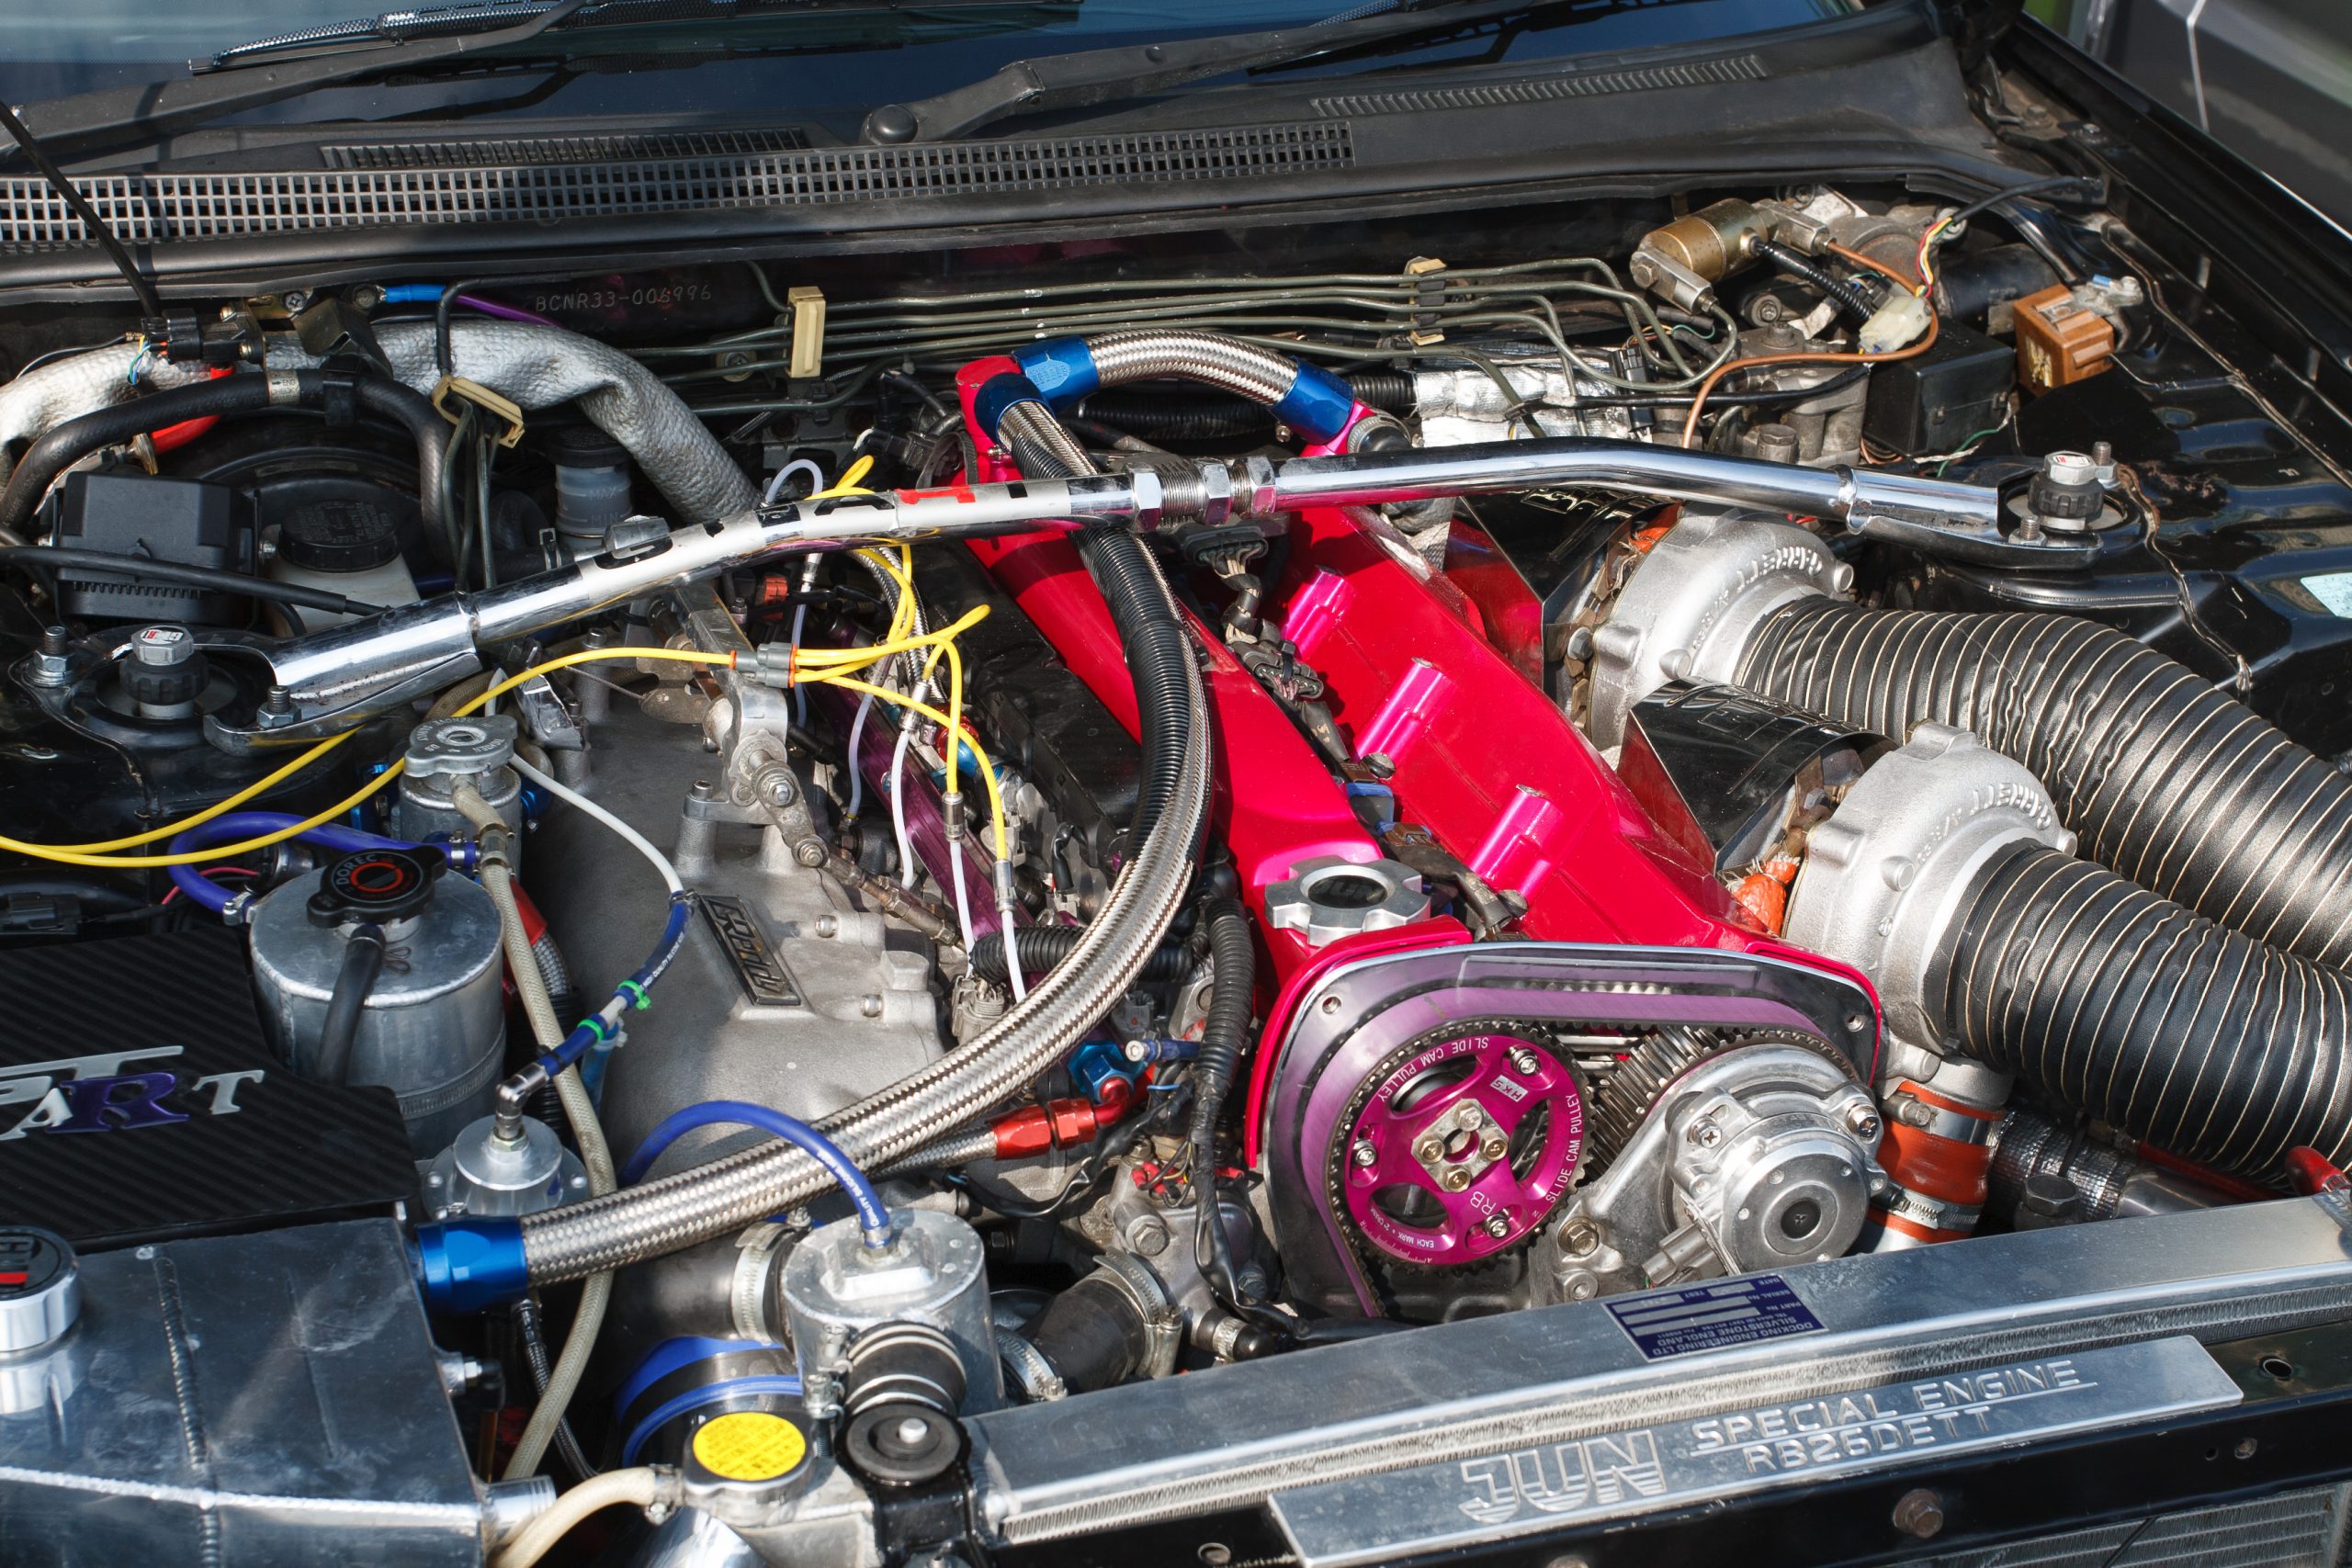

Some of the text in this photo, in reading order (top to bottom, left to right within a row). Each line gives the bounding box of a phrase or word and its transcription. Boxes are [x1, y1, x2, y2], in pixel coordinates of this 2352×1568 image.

[589, 487, 616, 501] MAX
[591, 513, 618, 526] MIN
[1736, 546, 1823, 594] GARRETT
[1968, 782, 2052, 831] GARRETT
[1378, 1037, 1490, 1103] SLIDE CAM PULLEY
[1493, 1079, 1522, 1100] HKS
[1545, 1093, 1585, 1204] SLIDE CAM PULLEY
[1470, 1190, 1498, 1216] RB
[1397, 1231, 1415, 1245] MARK
[1417, 1238, 1435, 1248] EACH
[1760, 1290, 1792, 1299] SERIAL
[1781, 1302, 1802, 1310] PART
[1652, 1323, 1815, 1356] DOCKING ENGINEERING LTD
[1657, 1316, 1797, 1348] SILVERSTONE ENGLAND
[1691, 1359, 2081, 1450] SPECIAL ENGINE
[1742, 1405, 1991, 1473] RB26DETT
[1458, 1429, 1668, 1525] JUN
